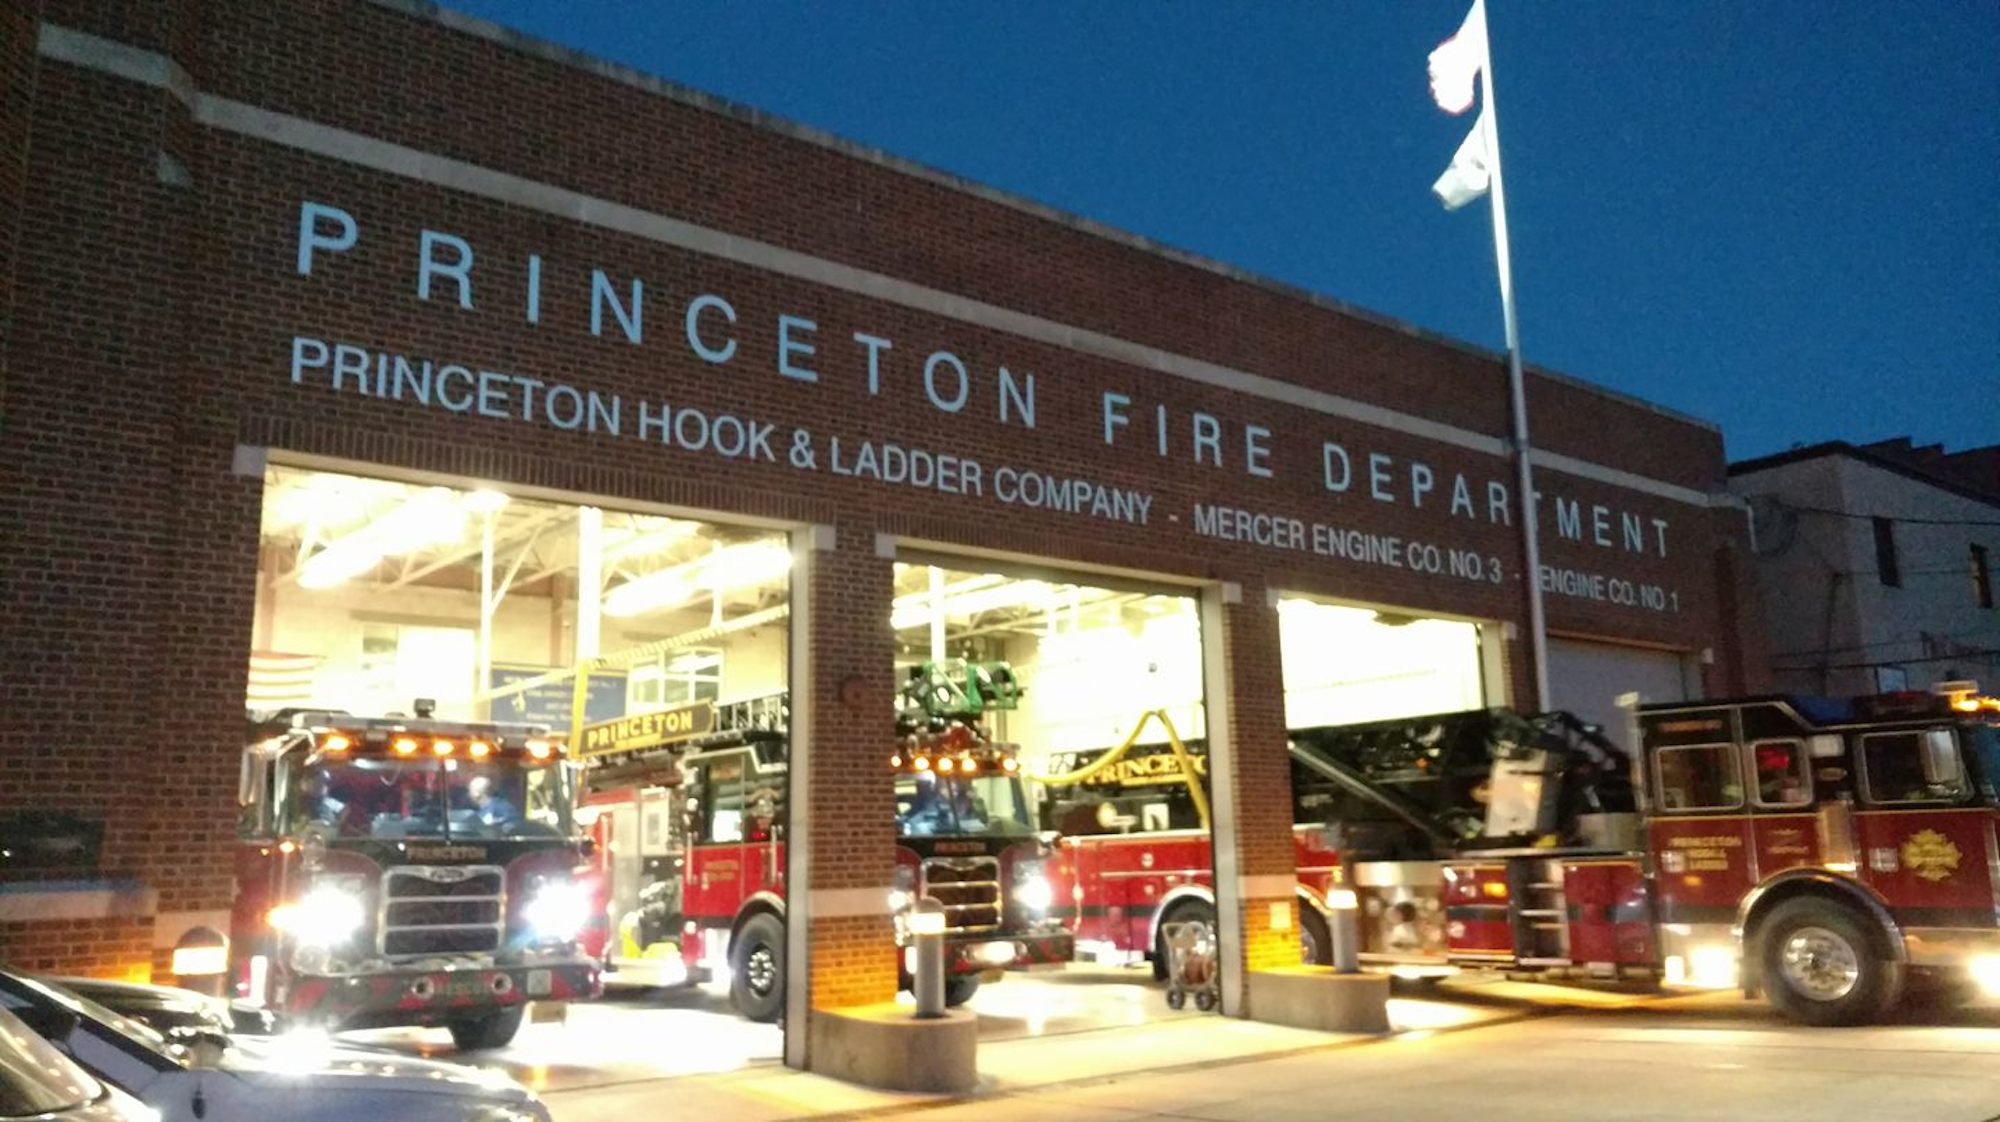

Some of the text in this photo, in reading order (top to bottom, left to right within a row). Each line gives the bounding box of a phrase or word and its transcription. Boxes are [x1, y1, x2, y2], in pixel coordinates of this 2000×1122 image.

[291, 336, 621, 436] PRINCETON
[638, 401, 775, 462] HOOK
[788, 428, 817, 470] &
[831, 436, 982, 497] LADDER
[994, 467, 1153, 525] COMPANY
[1193, 503, 1305, 550] MERCER
[1312, 524, 1402, 567] ENGINE
[1407, 541, 1445, 573] CO.
[1449, 548, 1485, 580] NO.
[1489, 556, 1502, 584] 3
[1539, 564, 1605, 601] ENGINE
[1670, 590, 1679, 612] 1
[297, 201, 1035, 428] PRINCETON
[1102, 391, 1273, 478] FIRE
[587, 710, 693, 750] PRINCETON
